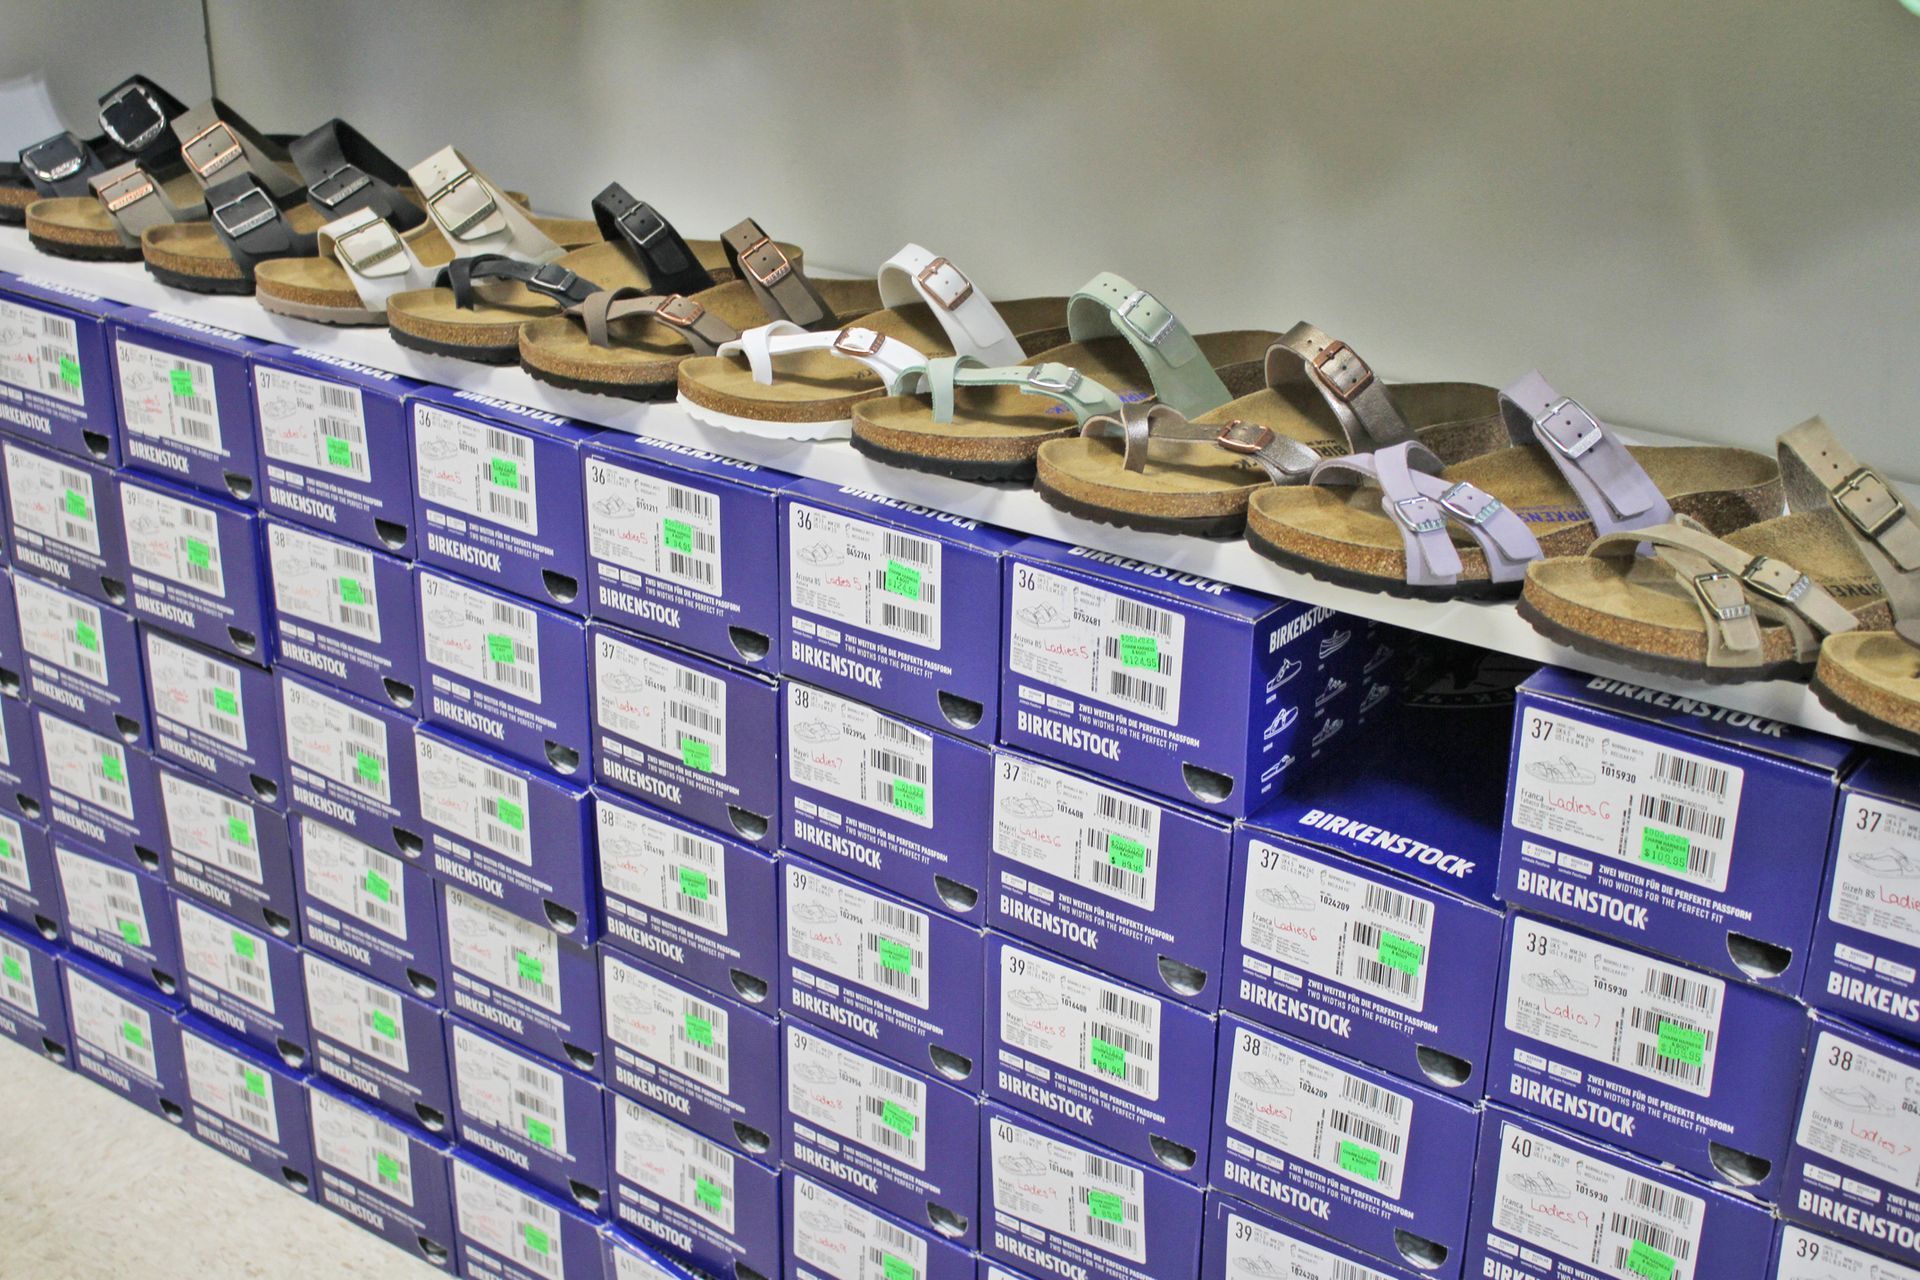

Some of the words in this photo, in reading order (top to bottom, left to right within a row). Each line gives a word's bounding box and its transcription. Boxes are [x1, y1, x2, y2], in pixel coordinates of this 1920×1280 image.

[260, 372, 271, 389] 37
[418, 409, 431, 428] 36
[129, 439, 190, 474] BIRKENSTOCK
[592, 465, 606, 486] 36
[269, 486, 337, 523] BIRKENSTOCK
[797, 509, 812, 531] 36
[274, 531, 285, 548] 38
[427, 532, 501, 573] BIRKENSTOCK
[16, 545, 71, 580] BIRKENSTOCK
[426, 579, 438, 596] 37
[1018, 569, 1035, 591] 36
[134, 592, 195, 629] BIRKENSTOCK
[599, 585, 680, 629] BIRKENSTOCK
[281, 639, 347, 679] BIRKENSTOCK
[602, 641, 614, 660] 37
[791, 640, 882, 689] BIRKENSTOCK
[794, 688, 809, 708] 38
[1586, 677, 1784, 739] BIRKENSTOCK
[433, 696, 505, 741] BIRKENSTOCK
[1531, 718, 1553, 742] 37
[1018, 710, 1121, 761] BIRKENSTOCK
[159, 733, 217, 773] BIRKENSTOCK
[420, 742, 432, 760] 38
[603, 758, 682, 804] BIRKENSTOCK
[1003, 762, 1020, 782] 37
[1601, 766, 1636, 784] 1015930
[293, 784, 356, 826] BIRKENSTOCK
[1521, 788, 1544, 803] Franca
[601, 808, 615, 827] 38
[1856, 807, 1882, 833] 37
[795, 819, 882, 870] BIRKENSTOCK
[1299, 808, 1474, 878] BIRKENSTOCK
[1260, 848, 1279, 871] 37
[174, 867, 232, 907] BIRKENSTOCK
[434, 853, 504, 899] BIRKENSTOCK
[793, 871, 807, 891] 39
[450, 890, 462, 906] 39
[1320, 894, 1350, 912] 1024209
[1517, 868, 1648, 931] BIRKENSTOCK
[1598, 876, 1613, 887] TWO
[1615, 880, 1643, 898] WIDTHS
[1645, 889, 1659, 901] FOR
[1662, 894, 1675, 907] THE
[1677, 898, 1710, 919] PERFECT
[1711, 909, 1723, 923] FIT
[1599, 865, 1617, 877] ZWEI
[1618, 870, 1644, 886] WEITEN
[1646, 878, 1660, 891] FÜR
[1662, 883, 1674, 895] DIE
[1675, 887, 1711, 908] PERFEKTE
[1712, 899, 1752, 921] PASSFORM
[1842, 881, 1863, 896] Gizeh
[1865, 888, 1876, 899] BS
[1000, 895, 1098, 950] BIRKENSTOCK
[308, 923, 371, 965] BIRKENSTOCK
[607, 916, 685, 964] BIRKENSTOCK
[1526, 932, 1548, 956] 38
[613, 966, 625, 983] 39
[1009, 956, 1025, 976] 39
[1594, 980, 1628, 998] 1015930
[454, 990, 524, 1035] BIRKENSTOCK
[792, 987, 879, 1039] BIRKENSTOCK
[1240, 979, 1351, 1039] BIRKENSTOCK
[794, 1032, 807, 1051] 39
[1242, 1033, 1261, 1057] 38
[1828, 1046, 1853, 1071] 38
[319, 1056, 380, 1099] BIRKENSTOCK
[616, 1065, 690, 1115] BIRKENSTOCK
[1300, 1082, 1328, 1099] 1024209
[999, 1071, 1093, 1126] BIRKENSTOCK
[1510, 1073, 1635, 1137] BIRKENSTOCK
[626, 1103, 640, 1121] 40
[1812, 1110, 1833, 1126] Gizeh
[998, 1124, 1013, 1143] 40
[1511, 1135, 1532, 1158] 40
[462, 1125, 530, 1171] BIRKENSTOCK
[794, 1142, 879, 1194] BIRKENSTOCK
[800, 1182, 814, 1200] 40
[1224, 1160, 1331, 1222] BIRKENSTOCK
[1575, 1184, 1608, 1203] 1015930
[619, 1202, 693, 1253] BIRKENSTOCK
[1235, 1221, 1252, 1243] 39
[995, 1231, 1087, 1280] BIRKENSTOCK
[1796, 1238, 1819, 1261] 39
